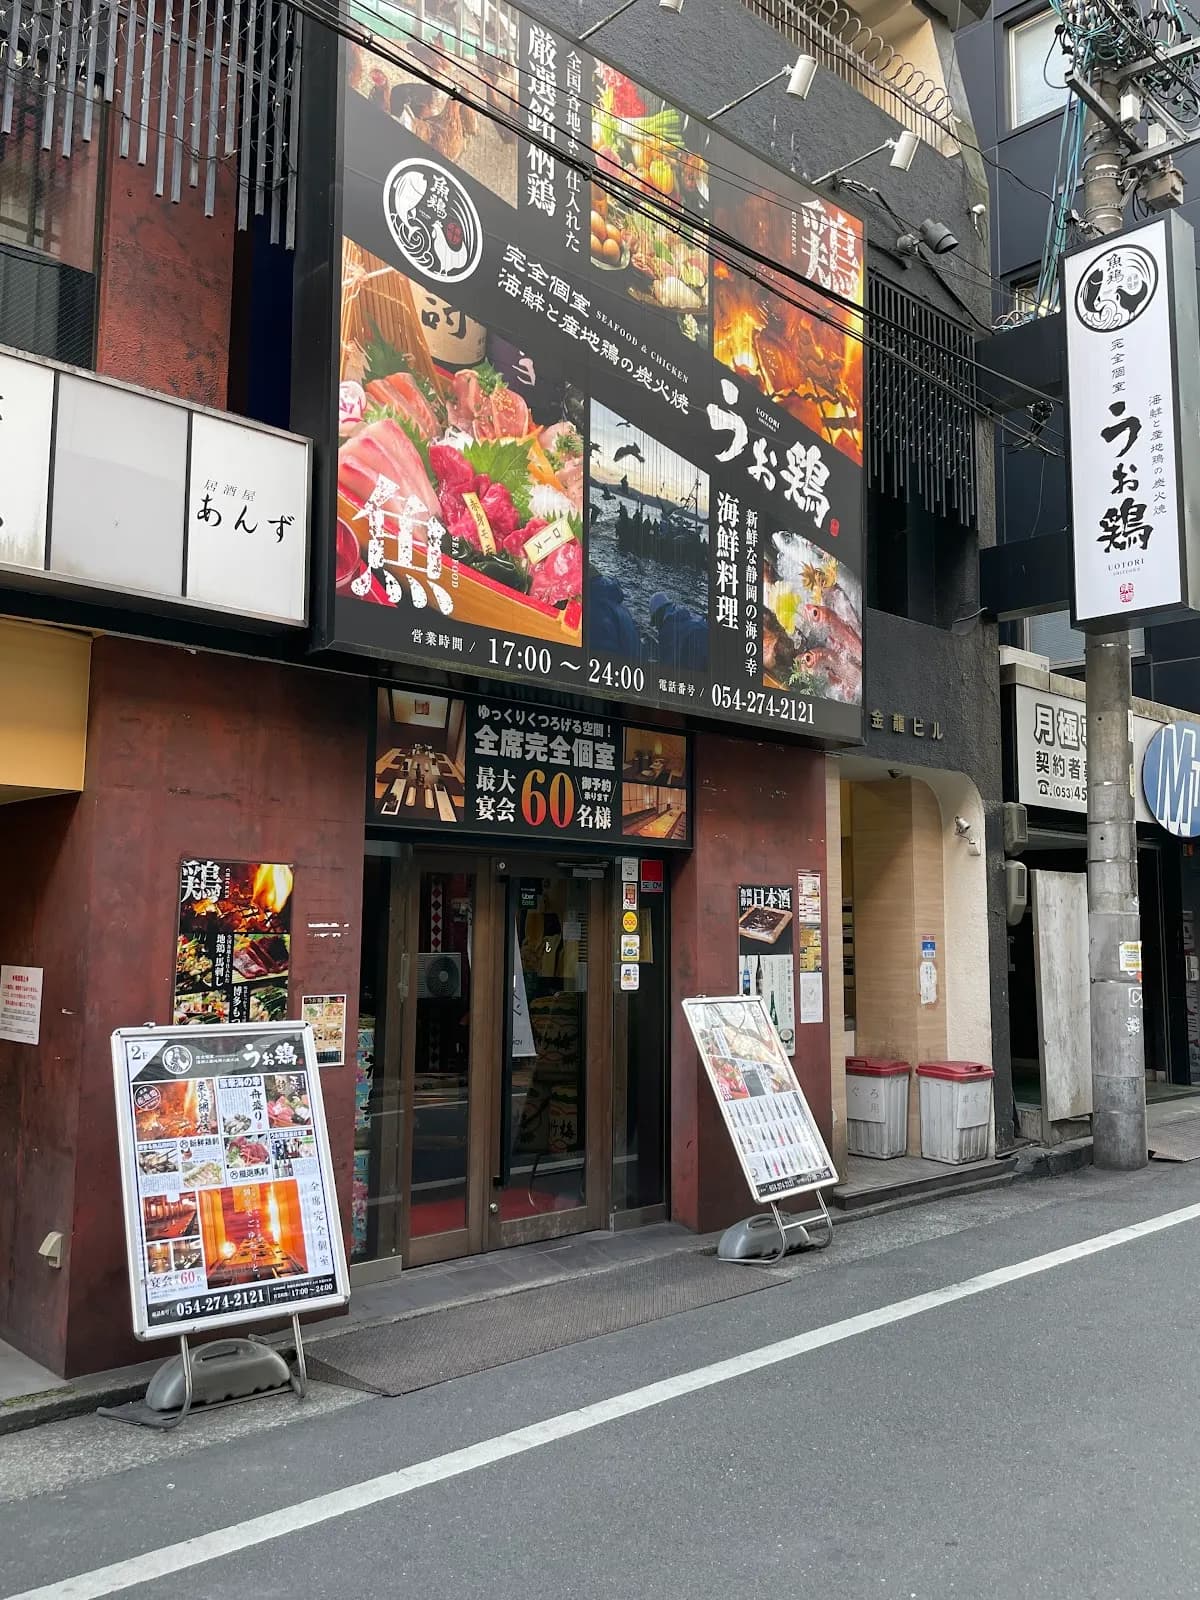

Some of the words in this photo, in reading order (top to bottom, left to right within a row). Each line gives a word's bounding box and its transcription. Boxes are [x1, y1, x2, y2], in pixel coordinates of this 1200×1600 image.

[527, 24, 557, 217] 厳選銘柄鶏
[565, 51, 581, 253] 全国各地よ仕入れた
[503, 244, 591, 318] 完全個室
[497, 267, 690, 415] 海鮮と産地鶏の炭火焼
[595, 310, 638, 346] SEAFOOD
[641, 344, 648, 354] &
[650, 351, 689, 384] CHICKEN
[1109, 337, 1127, 395] 完全個室
[756, 407, 781, 429] UOTORI
[706, 378, 831, 529] うお鶏
[1096, 400, 1154, 553] うお鶏
[204, 479, 256, 503] 居酒屋
[196, 493, 296, 543] あんず
[351, 472, 454, 616] 魚
[452, 535, 460, 555] SEA
[716, 490, 740, 630] 海鮮料理
[1107, 557, 1145, 571] UOTORI
[745, 509, 759, 677] 新鮮な静岡の海の幸
[411, 628, 463, 652] 営業時間
[489, 638, 551, 674] 17:00
[589, 658, 644, 692] 24:00
[658, 678, 696, 698] 電話番号
[711, 683, 815, 725] 054-274-2121
[473, 724, 616, 771] 全席完全個室
[1033, 702, 1087, 751] 月極
[581, 776, 612, 793] 御予約
[1035, 750, 1087, 784] 契約者
[475, 795, 516, 823] 宴会
[476, 766, 517, 794] 最大
[521, 768, 575, 829] 60
[577, 804, 612, 830] 名様
[181, 859, 223, 904] 鶏
[242, 1042, 298, 1068] うお鶏
[249, 1088, 264, 1121] 舟盛り
[176, 1288, 264, 1317] 054-274-2121
[181, 1271, 195, 1285] 60
